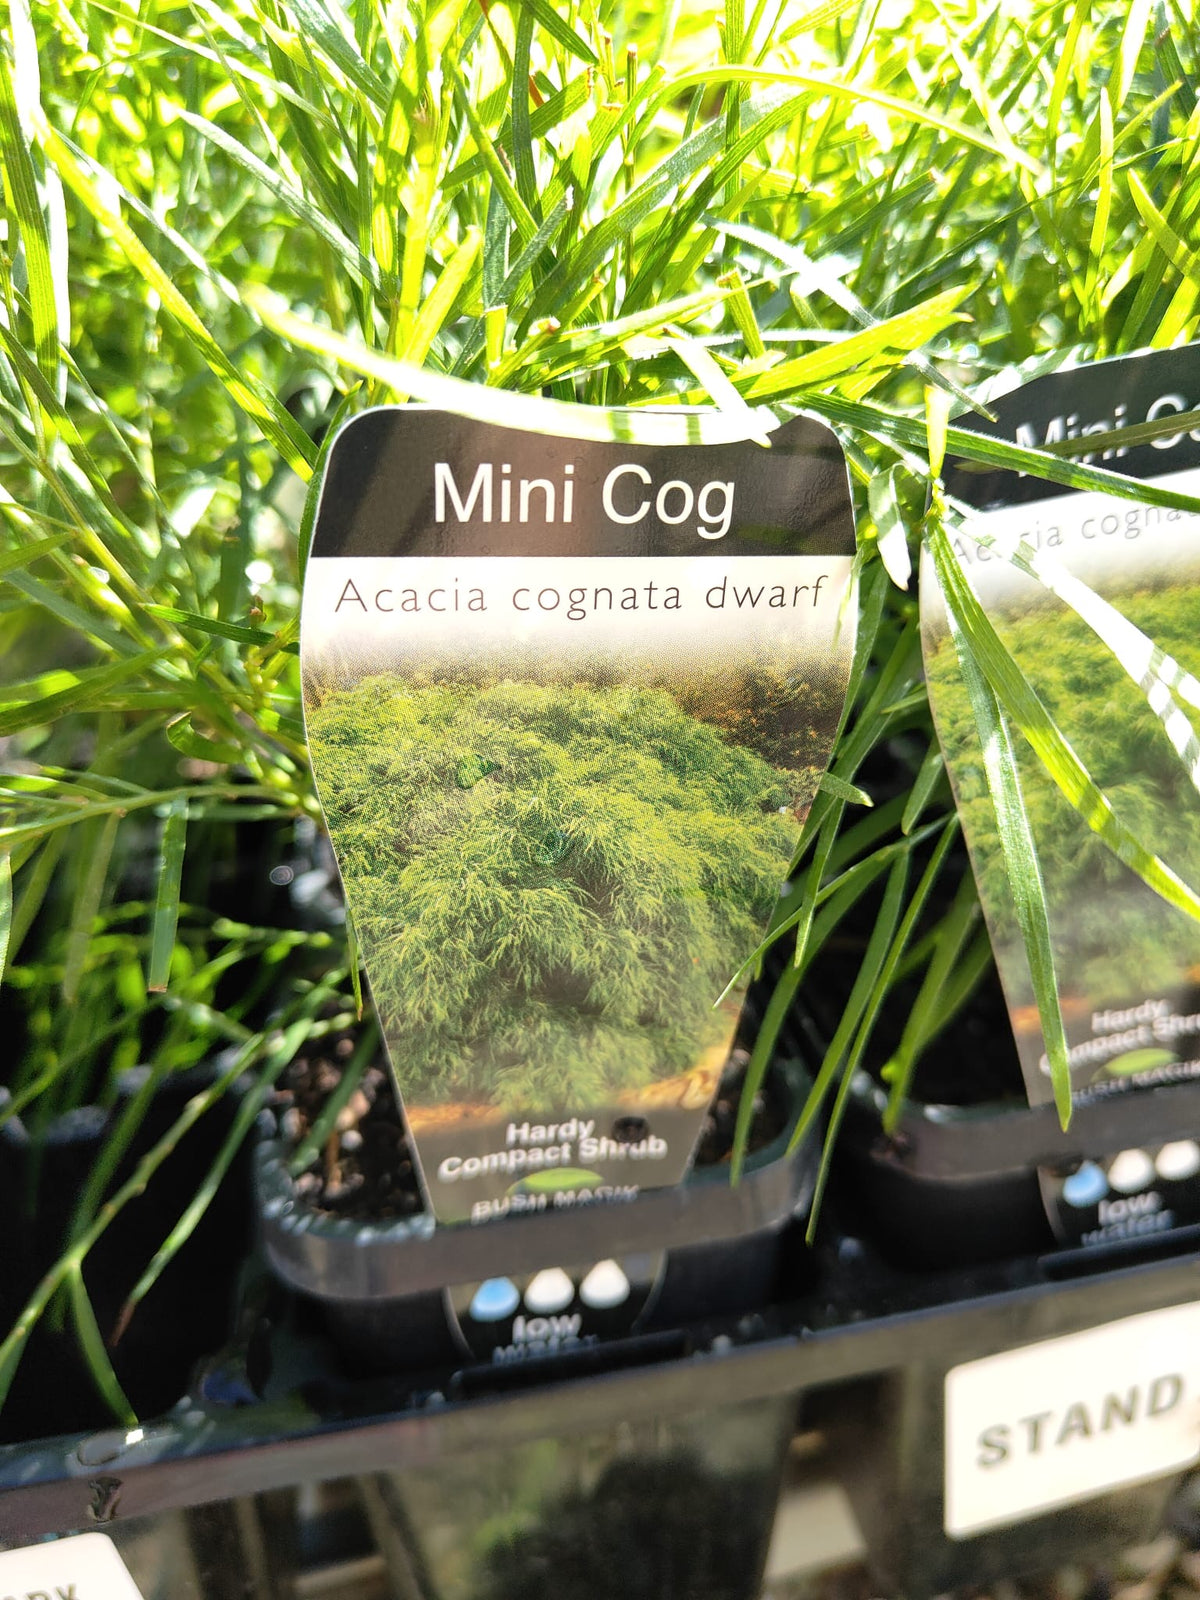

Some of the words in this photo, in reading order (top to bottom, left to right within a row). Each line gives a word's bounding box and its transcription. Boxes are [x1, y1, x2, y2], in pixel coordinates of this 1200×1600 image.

[433, 462, 575, 524] Mini
[601, 462, 736, 540] Cog
[1081, 506, 1200, 540] cogna
[334, 577, 488, 613] Acacia
[512, 579, 683, 621] cognata
[705, 575, 829, 609] dwarf
[1090, 998, 1171, 1033] Hardy
[505, 1117, 596, 1147] Hardy
[437, 1141, 573, 1184] Compact
[578, 1133, 669, 1165] Shrub
[1098, 1191, 1163, 1226] low
[512, 1312, 582, 1344] low
[975, 1373, 1187, 1470] STAND
